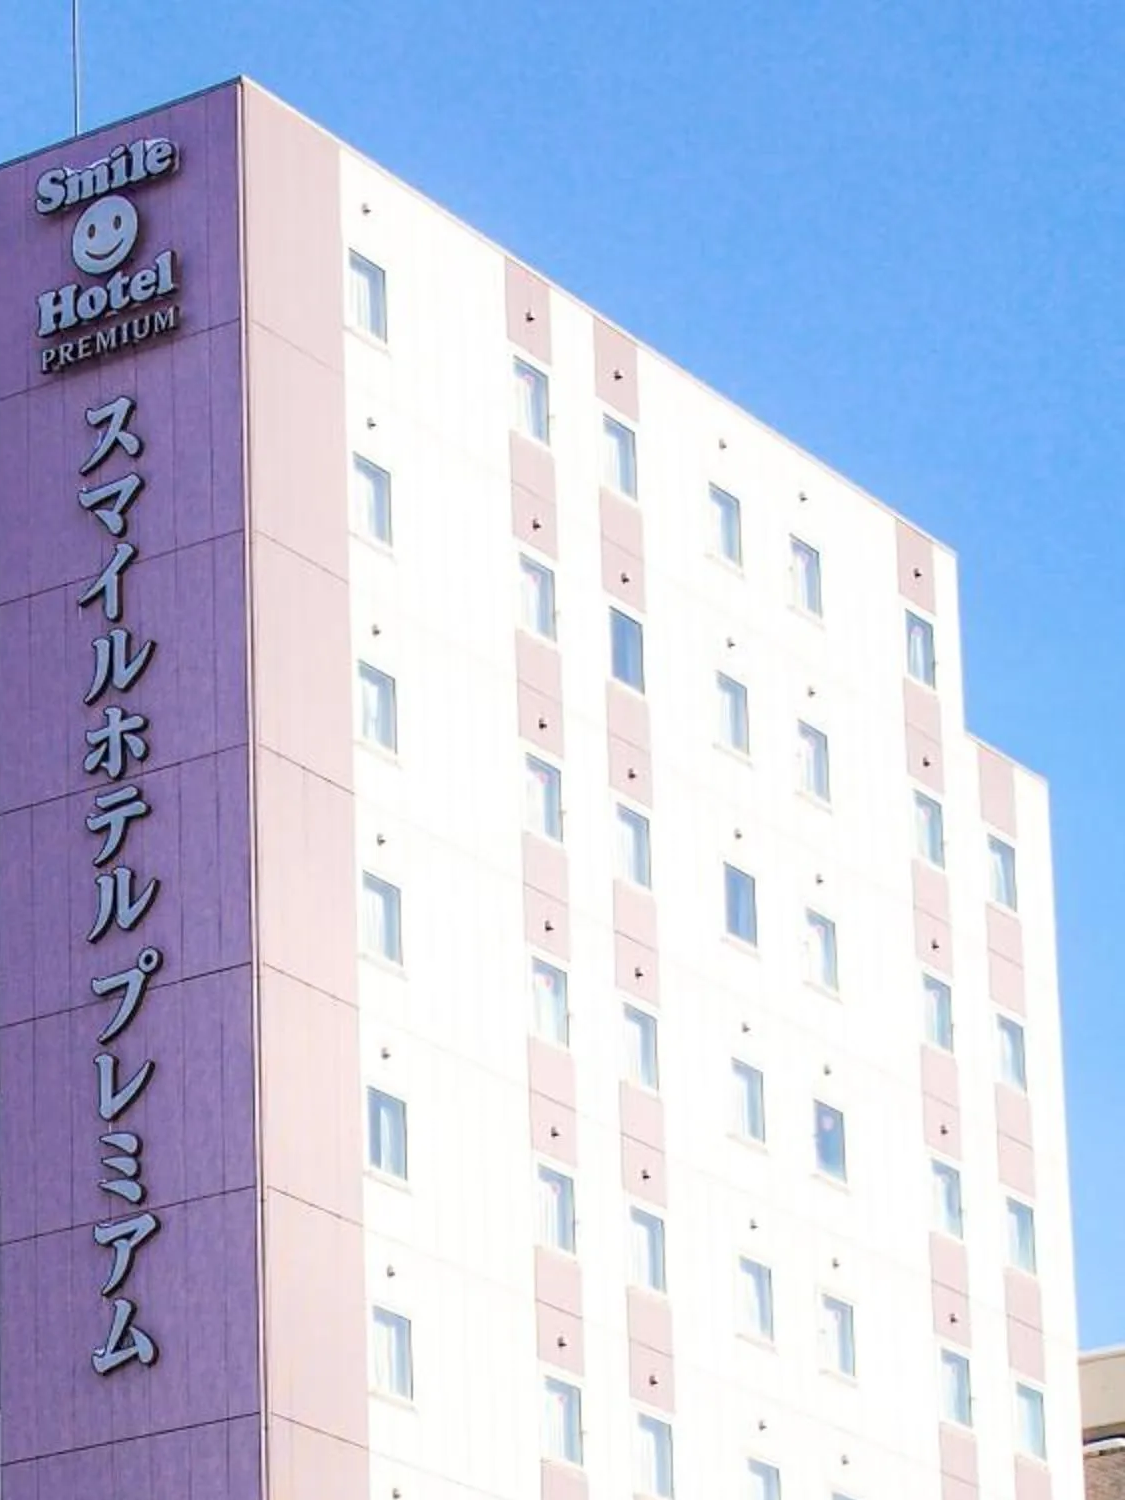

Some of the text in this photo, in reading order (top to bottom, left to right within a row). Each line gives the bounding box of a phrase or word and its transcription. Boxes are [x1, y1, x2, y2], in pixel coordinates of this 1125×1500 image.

[36, 138, 178, 214] Smile
[37, 250, 177, 337] Hotel
[41, 307, 179, 373] PREMIUM
[76, 395, 164, 1374] スマイルホテルプレミアム
